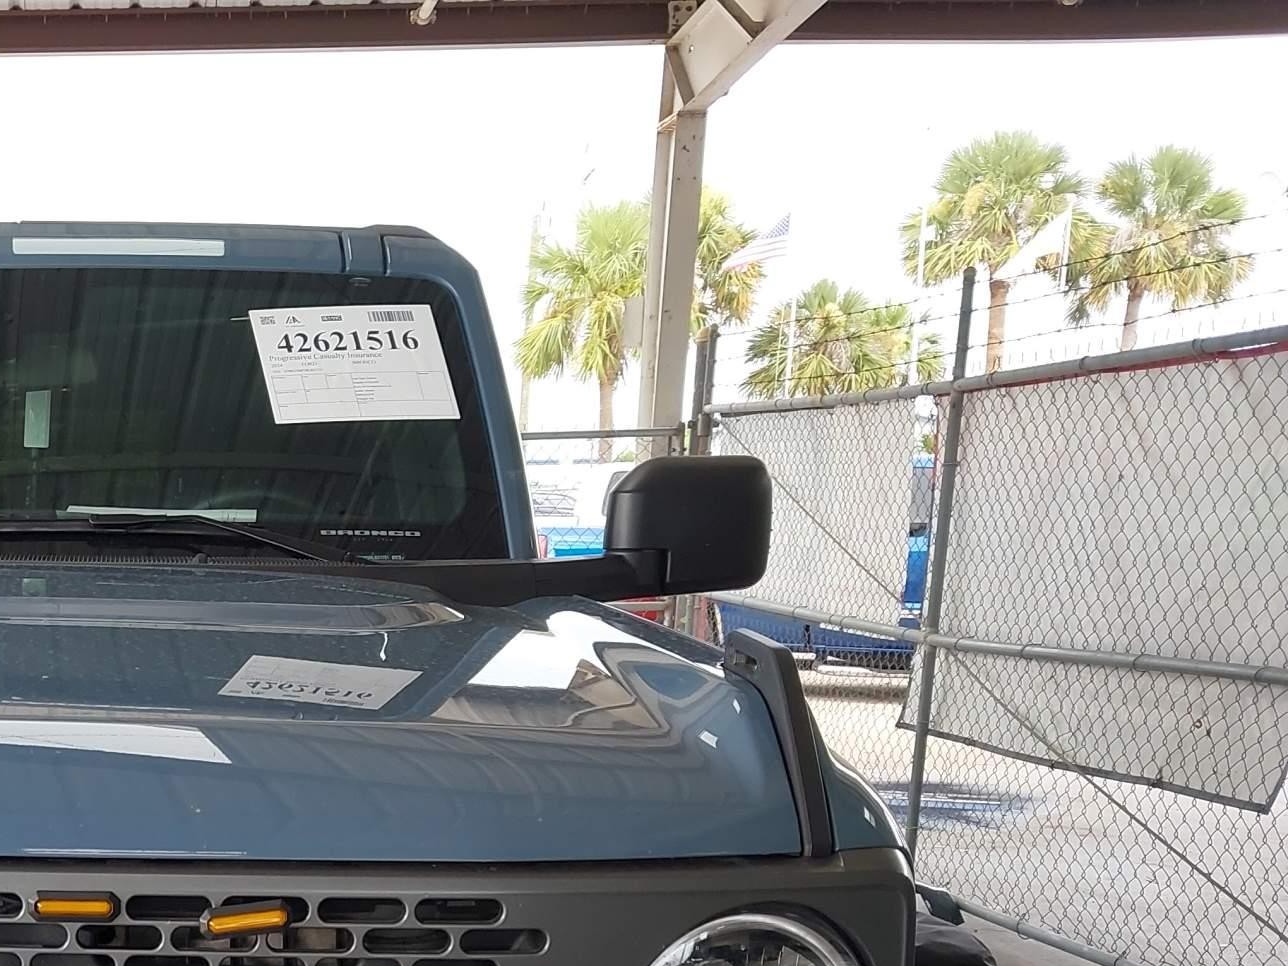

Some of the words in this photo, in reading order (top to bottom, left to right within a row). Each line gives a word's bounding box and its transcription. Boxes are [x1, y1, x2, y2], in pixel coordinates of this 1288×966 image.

[277, 330, 419, 352] 42621516
[269, 354, 312, 362] Progressive
[313, 352, 345, 360] Casualty
[320, 529, 422, 537] BRONCO
